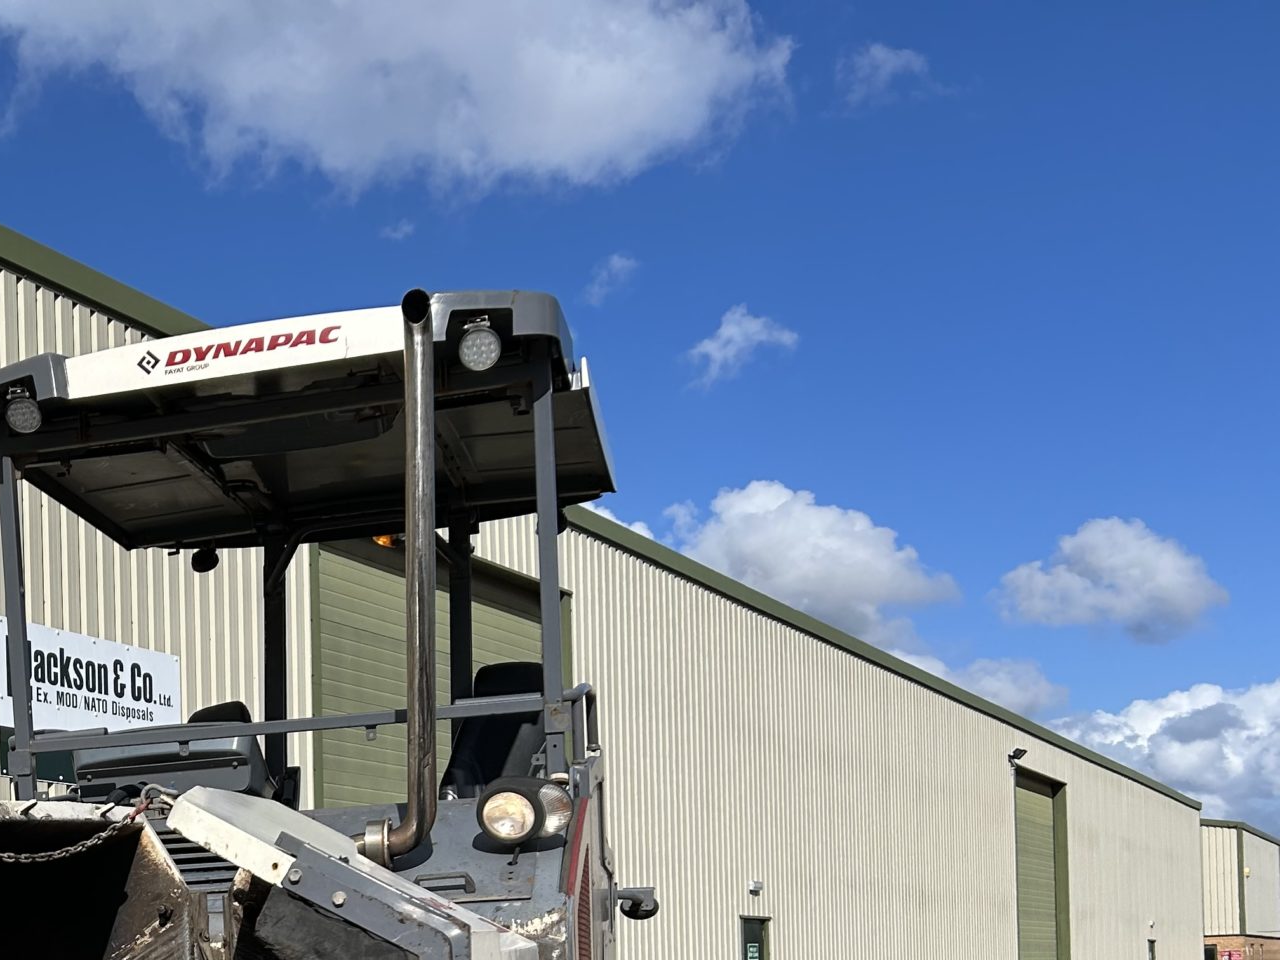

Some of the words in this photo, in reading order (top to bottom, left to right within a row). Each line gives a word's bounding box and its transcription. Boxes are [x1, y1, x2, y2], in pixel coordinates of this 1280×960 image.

[164, 325, 342, 368] DYNAPAC
[164, 366, 185, 376] FAYAT
[186, 362, 210, 372] GROUP
[113, 659, 127, 699] &
[130, 662, 158, 705] Co.
[158, 693, 174, 708] Ltd.
[36, 686, 52, 704] Ex.
[56, 690, 108, 714] MOD/NATO
[111, 700, 154, 722] Disposals
